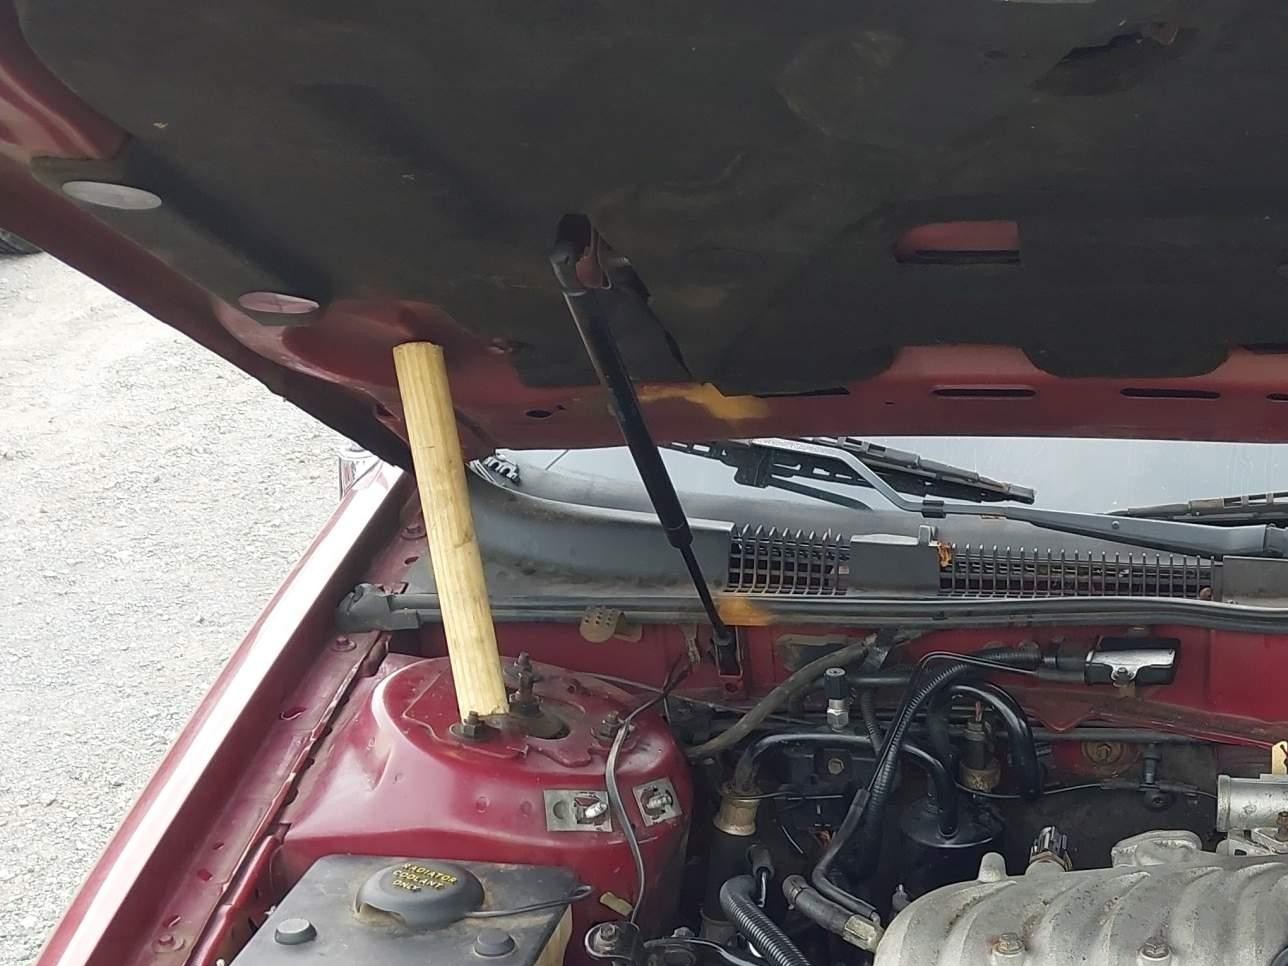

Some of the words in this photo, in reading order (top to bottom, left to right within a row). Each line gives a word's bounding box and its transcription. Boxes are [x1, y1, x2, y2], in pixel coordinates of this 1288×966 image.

[393, 870, 445, 889] COOLANT
[402, 863, 457, 884] RADIATOR
[392, 880, 421, 891] ONLY
